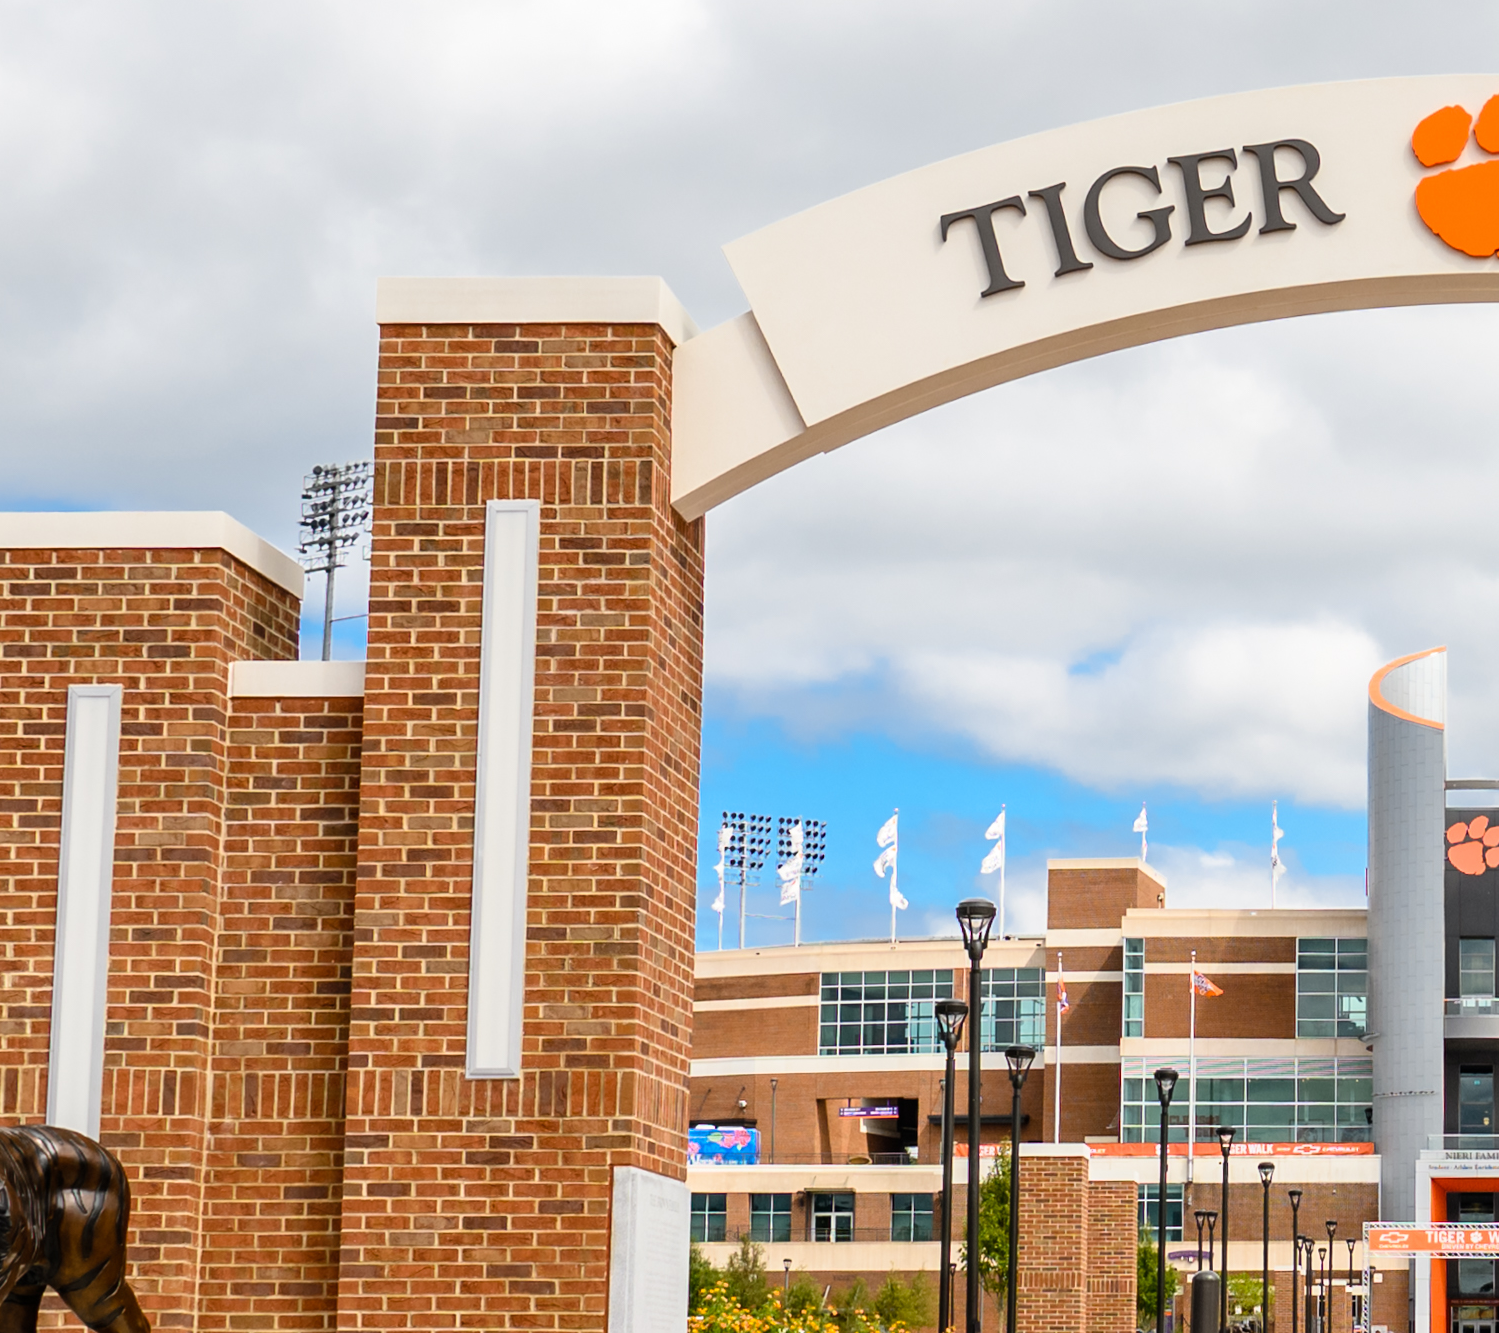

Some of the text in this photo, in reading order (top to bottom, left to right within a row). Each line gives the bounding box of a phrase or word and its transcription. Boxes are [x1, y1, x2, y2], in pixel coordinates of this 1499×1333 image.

[940, 138, 1346, 298] TIGER
[1248, 1144, 1273, 1154] WALK
[1445, 1152, 1472, 1160] NIERI
[1425, 1230, 1465, 1243] TIGER
